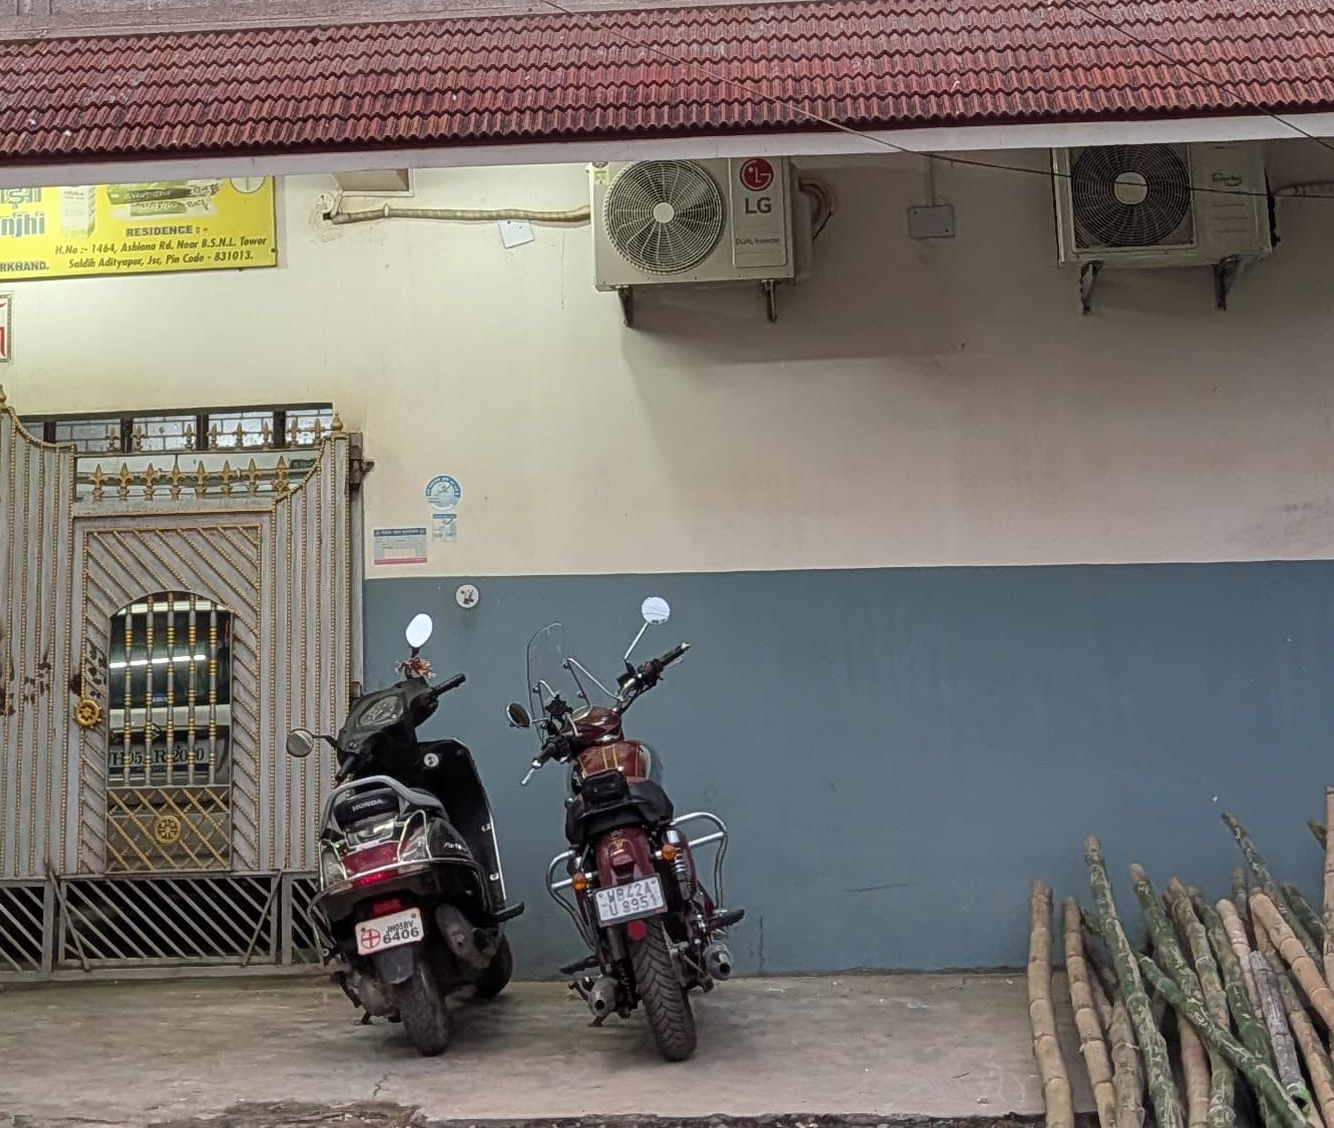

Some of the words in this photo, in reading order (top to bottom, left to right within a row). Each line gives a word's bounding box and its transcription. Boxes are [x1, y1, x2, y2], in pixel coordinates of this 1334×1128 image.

[745, 197, 772, 214] LG
[126, 226, 193, 237] RESIDENCE
[159, 239, 174, 250] Rd.
[177, 239, 199, 249] Near
[240, 236, 267, 246] Tower
[166, 254, 179, 264] Pin
[183, 252, 204, 263] Code
[173, 746, 205, 761] 200
[352, 798, 383, 812] HONDA
[383, 927, 420, 945] 6406
